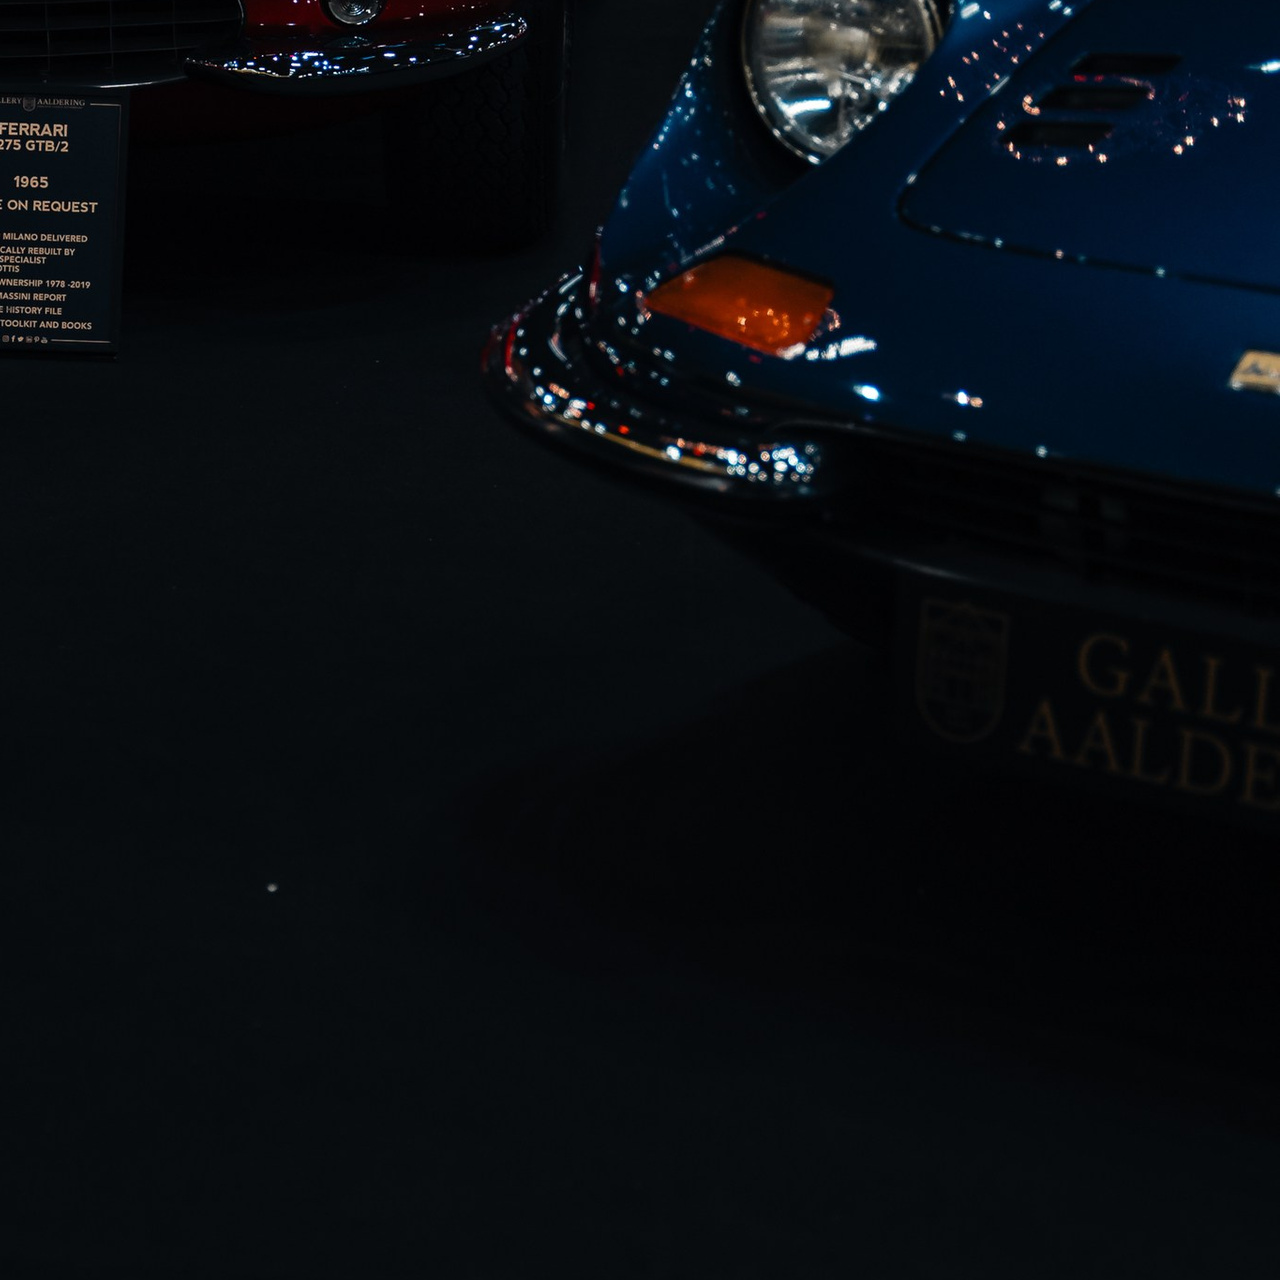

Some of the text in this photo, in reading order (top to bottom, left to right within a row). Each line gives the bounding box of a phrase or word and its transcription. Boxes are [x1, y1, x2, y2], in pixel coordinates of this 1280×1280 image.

[37, 99, 85, 108] AALDERING
[0, 122, 67, 137] FERRARI
[26, 140, 68, 152] GTB/2
[14, 176, 48, 188] 1965
[8, 200, 28, 210] ON
[33, 201, 98, 213] REQUEST
[41, 234, 88, 242] DELIVERED
[28, 247, 62, 255] REBUILT
[64, 247, 75, 256] BY
[0, 255, 46, 265] SPECIALIST
[33, 293, 66, 301] REPORT
[6, 306, 42, 314] HISTORY
[45, 307, 62, 315] FILE
